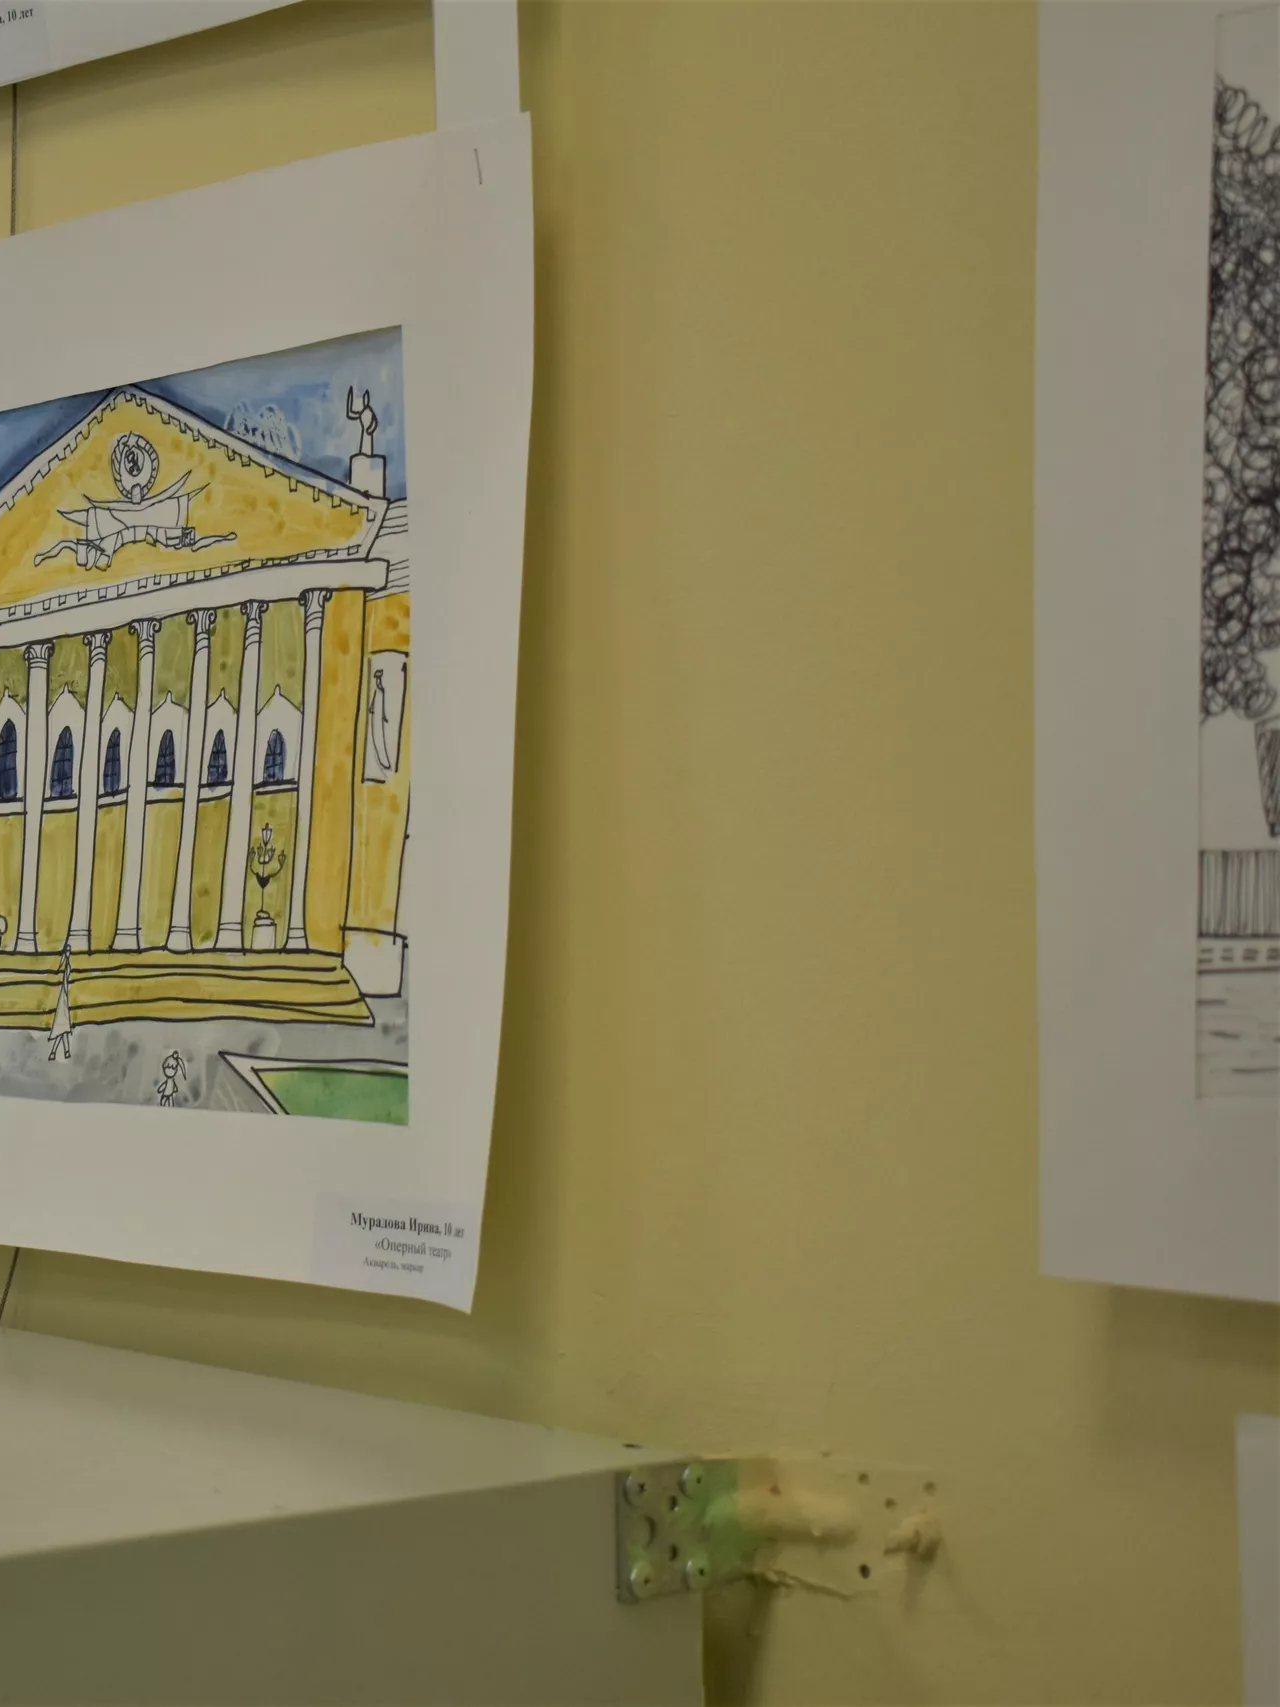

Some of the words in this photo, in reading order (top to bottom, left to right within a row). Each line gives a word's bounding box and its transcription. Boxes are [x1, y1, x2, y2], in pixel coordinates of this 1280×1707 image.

[8, 9, 17, 22] 10
[18, 8, 34, 20] лет
[350, 1212, 406, 1231] Мурадова
[409, 1217, 442, 1236] Ирина,
[444, 1222, 452, 1236] 10
[453, 1227, 465, 1239] лет
[375, 1237, 426, 1257] «Оперный
